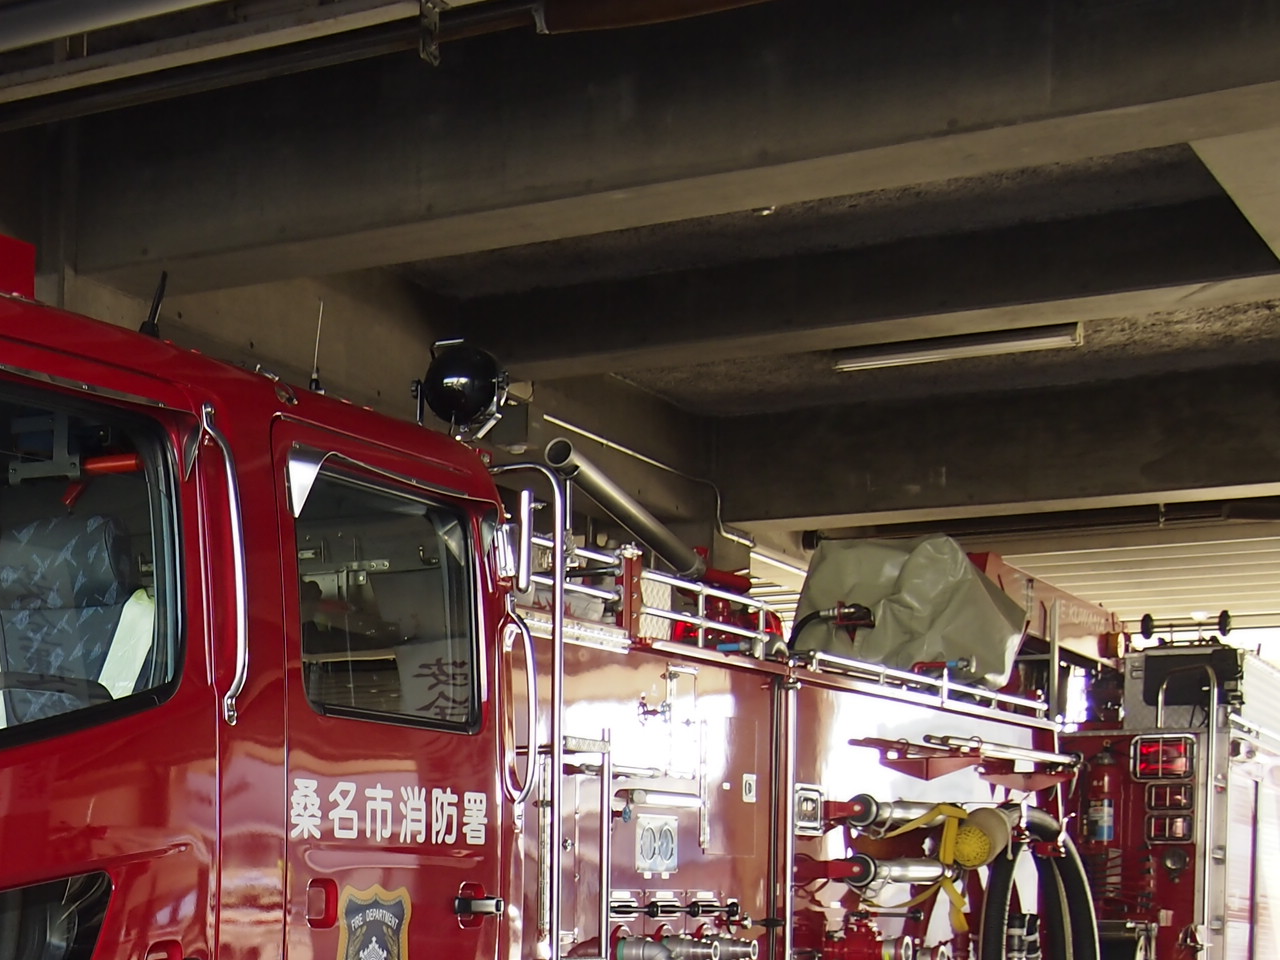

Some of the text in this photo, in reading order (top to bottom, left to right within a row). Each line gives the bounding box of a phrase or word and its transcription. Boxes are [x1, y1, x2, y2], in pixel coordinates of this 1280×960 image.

[290, 778, 488, 846] 桑名市消防署
[350, 908, 399, 932] FIRE DEPARTMENT
